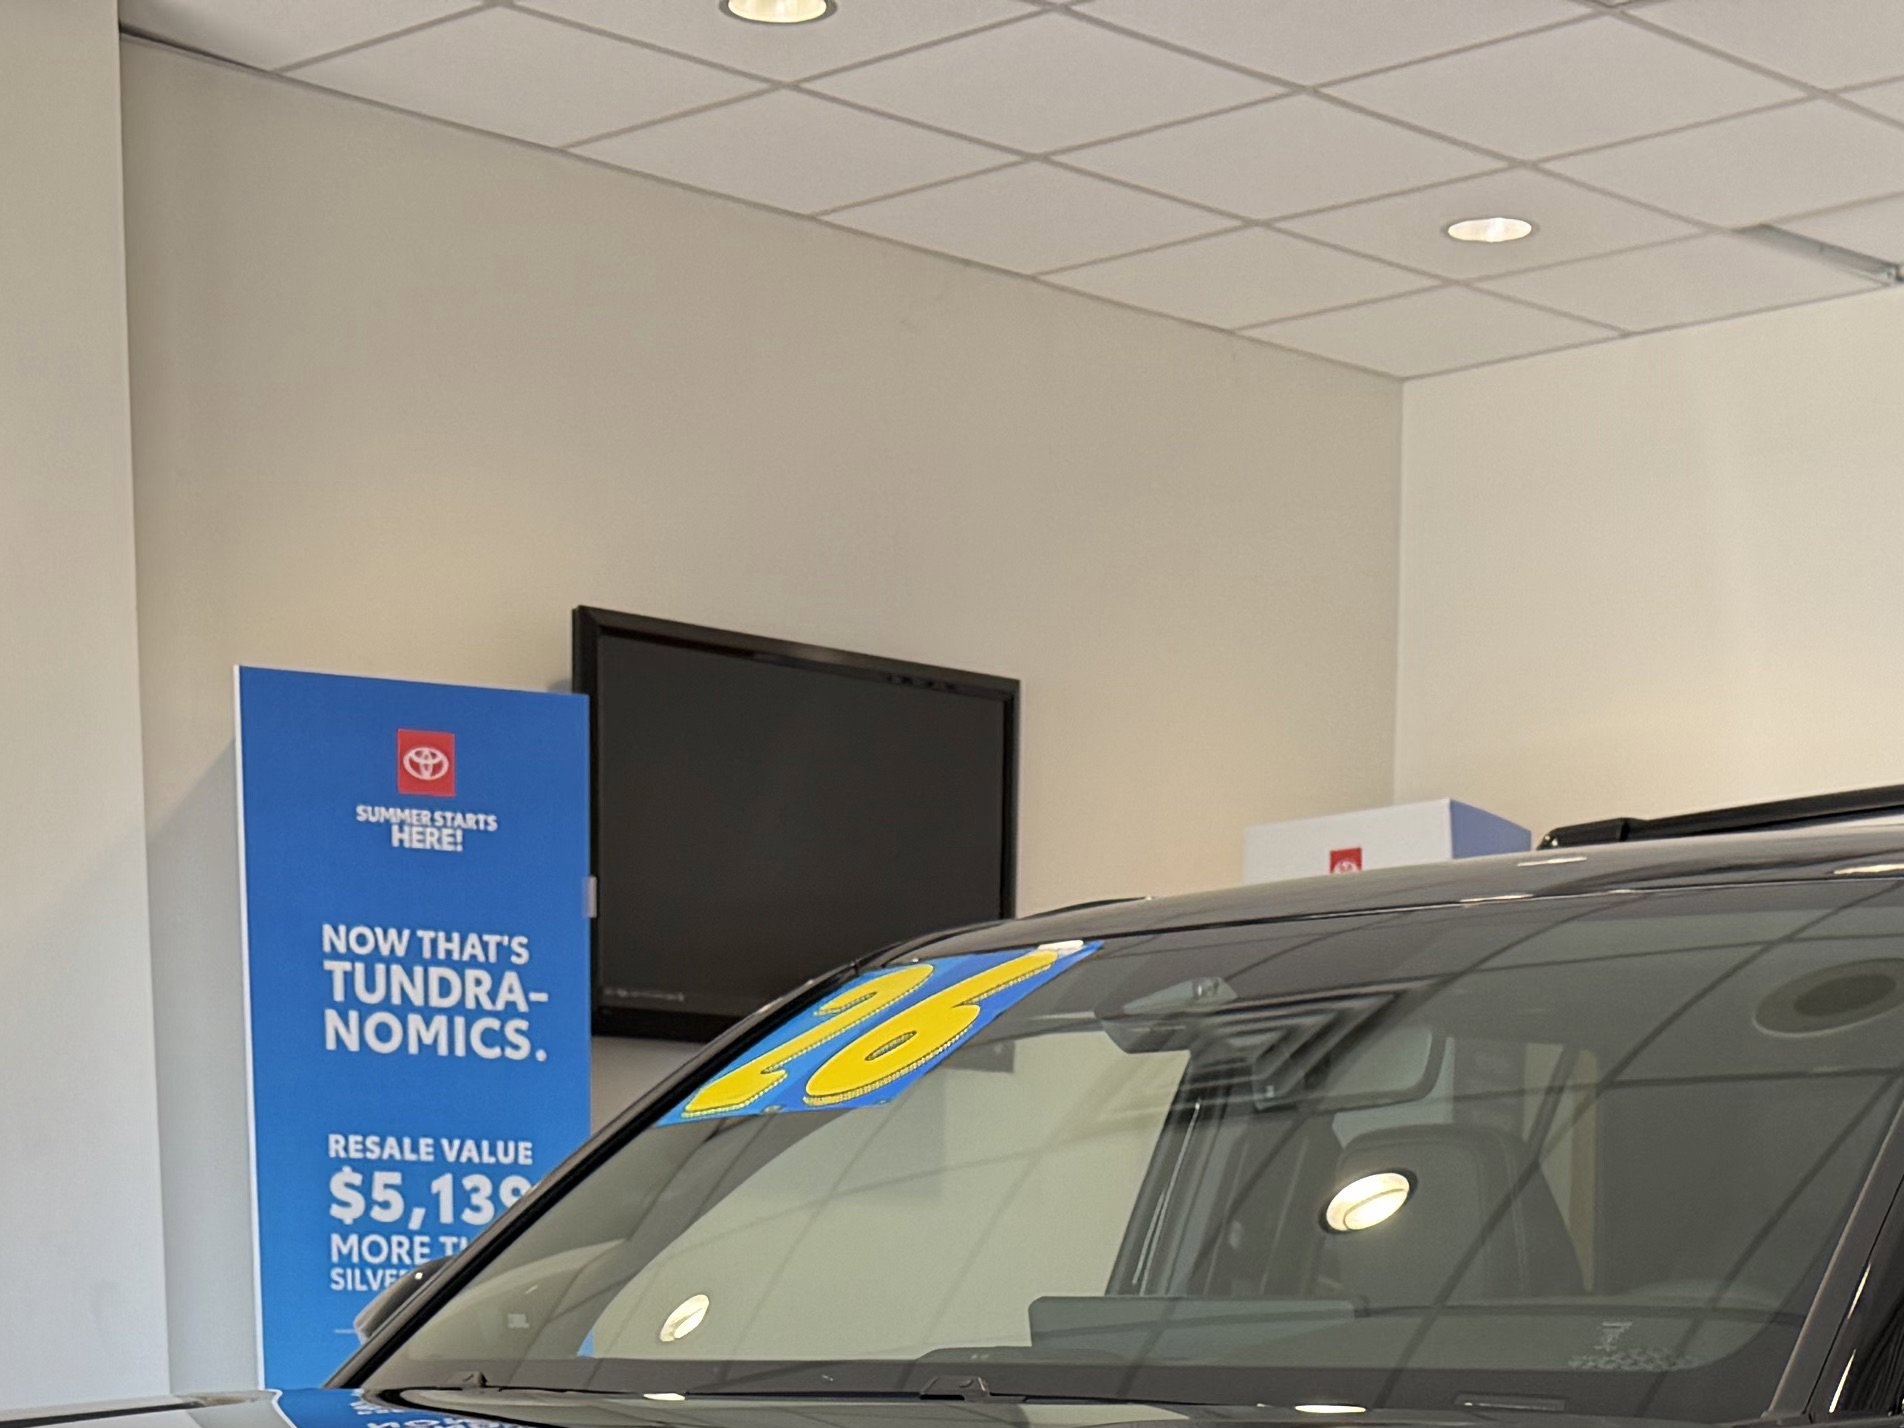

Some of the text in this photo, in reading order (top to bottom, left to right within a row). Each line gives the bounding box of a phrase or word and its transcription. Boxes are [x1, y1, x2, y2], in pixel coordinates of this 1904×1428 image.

[355, 804, 498, 832] SUMMER STARTS
[391, 824, 463, 852] HERE!
[322, 923, 530, 965] NOW THAT'S
[324, 1008, 548, 1062] NOMICS.
[328, 1133, 534, 1166] RESALE VALUE
[329, 1165, 533, 1230] $5,139
[330, 1233, 431, 1265] MORE
